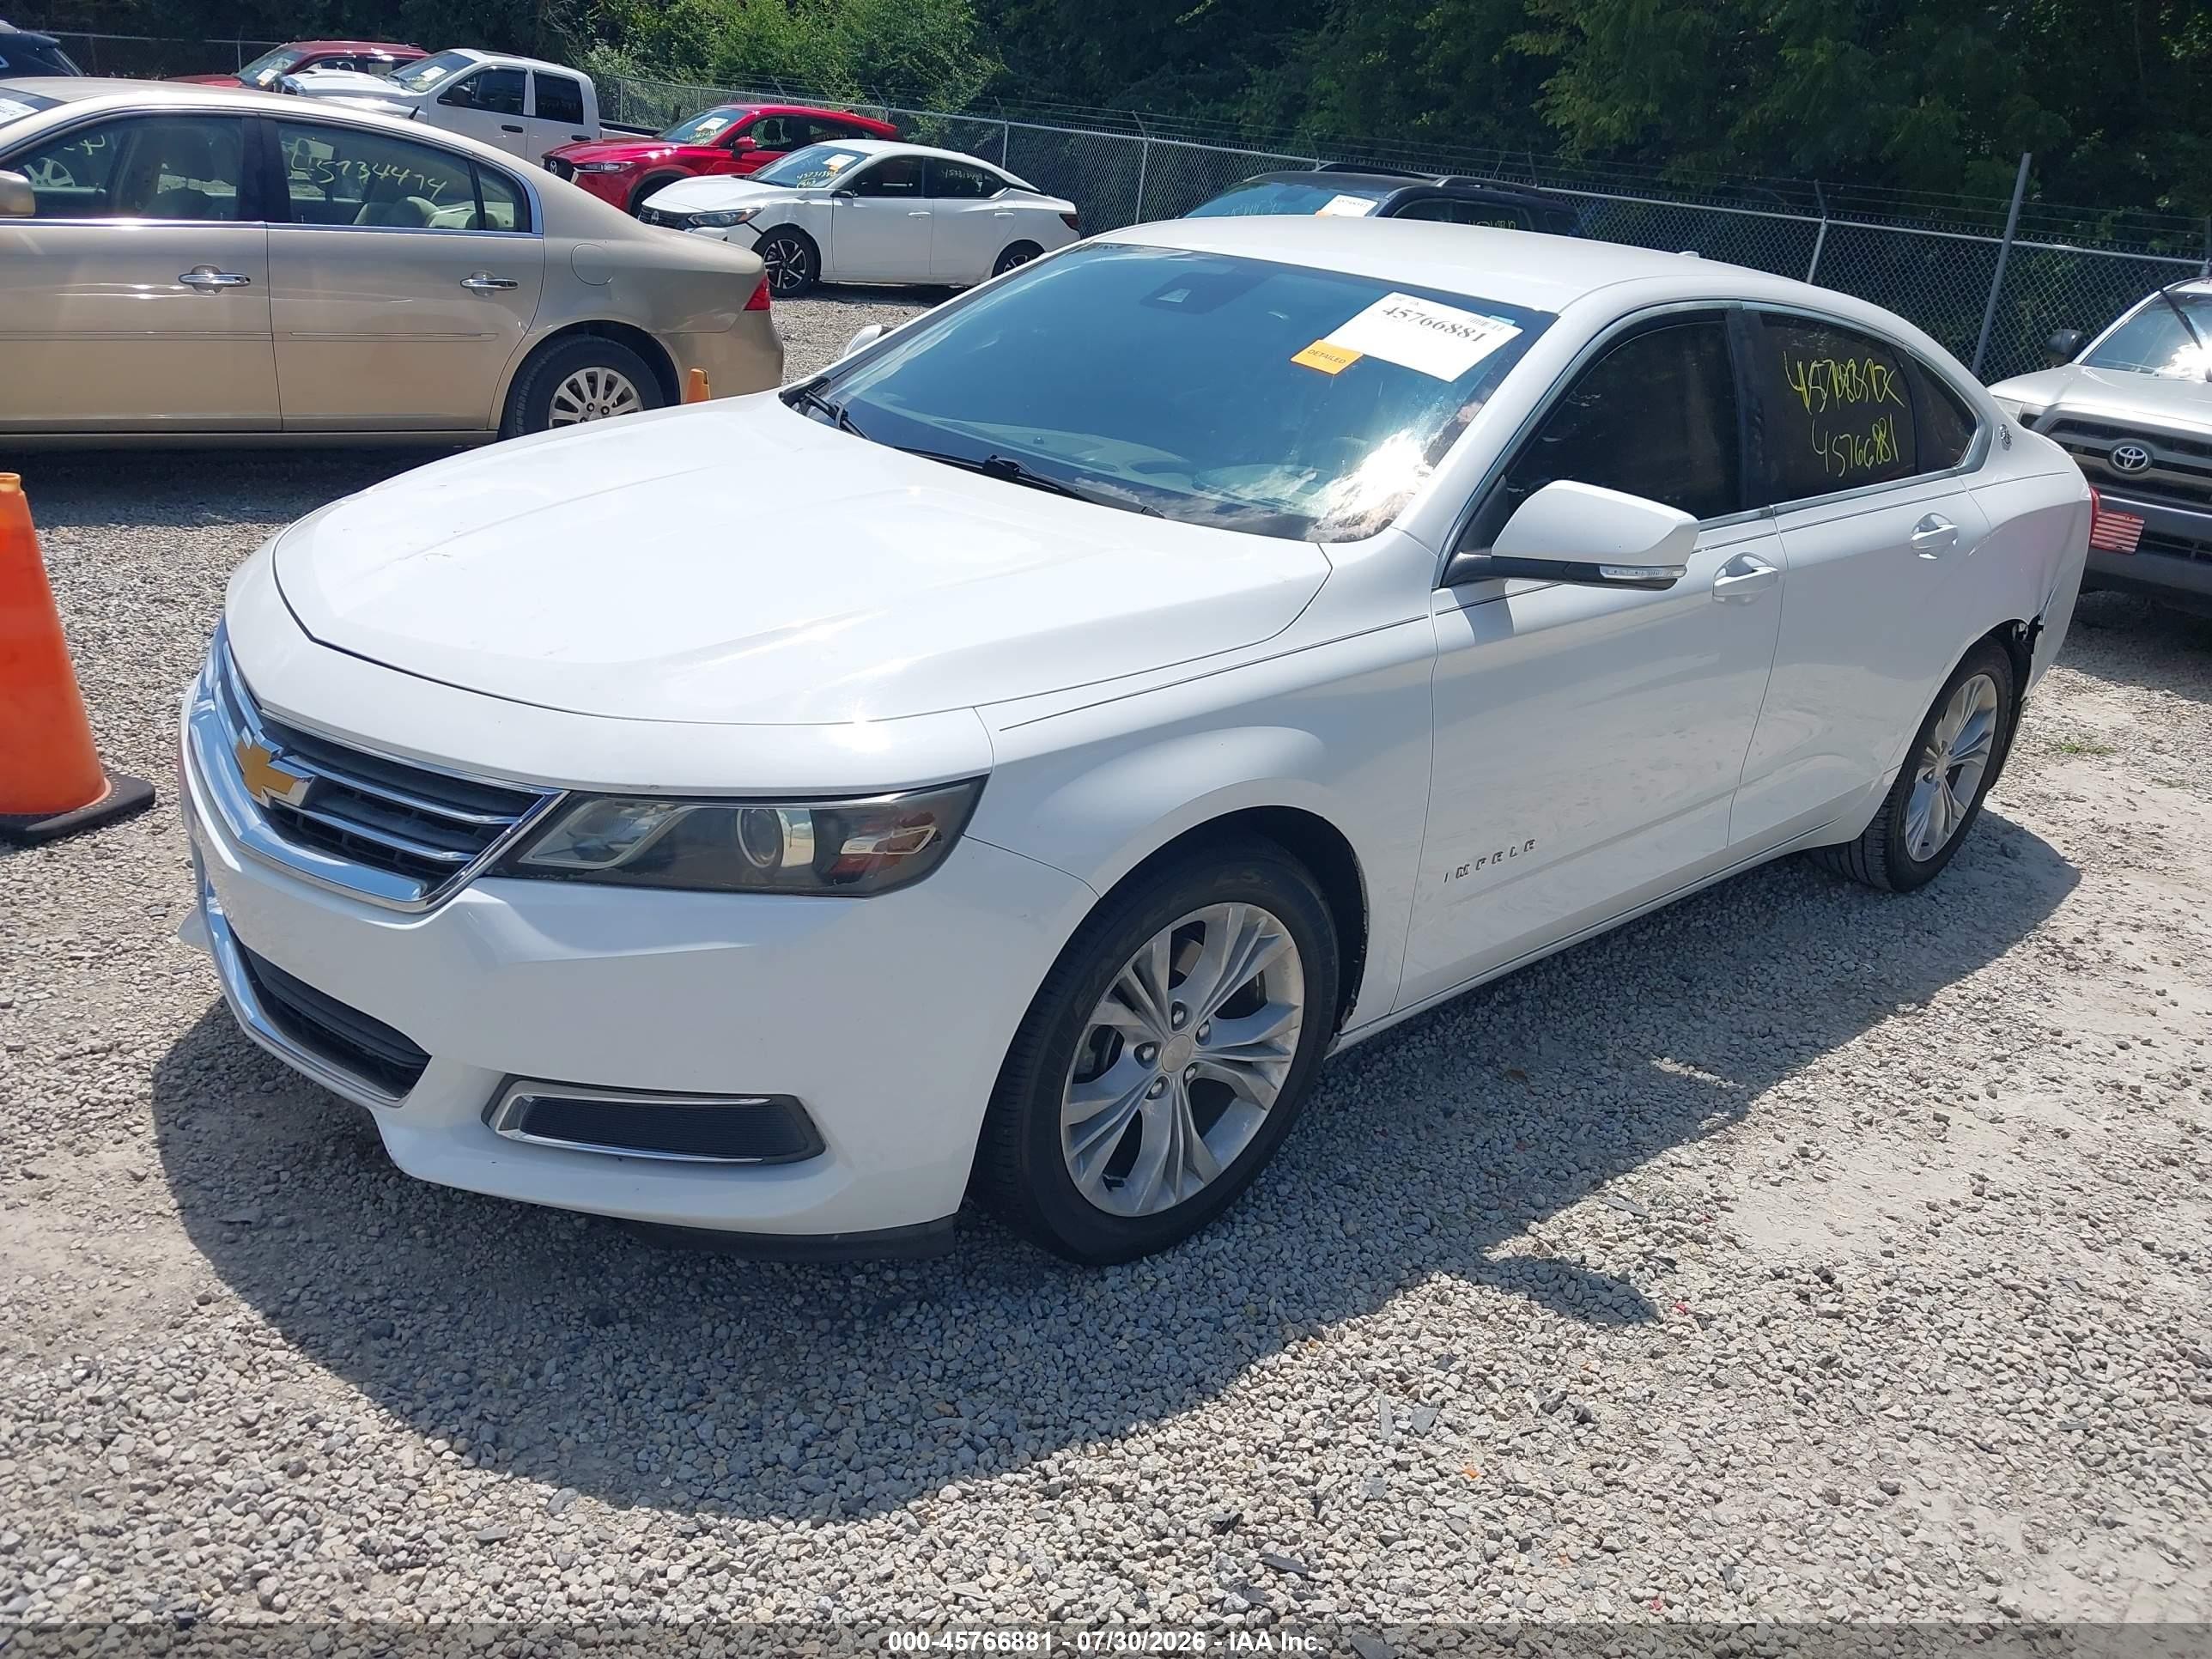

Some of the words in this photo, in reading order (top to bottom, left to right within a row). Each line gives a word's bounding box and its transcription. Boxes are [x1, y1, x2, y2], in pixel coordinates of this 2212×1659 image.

[1382, 307, 1486, 342] 45766881
[1308, 349, 1346, 364] DETAILED
[1812, 413, 1899, 477] 45766881
